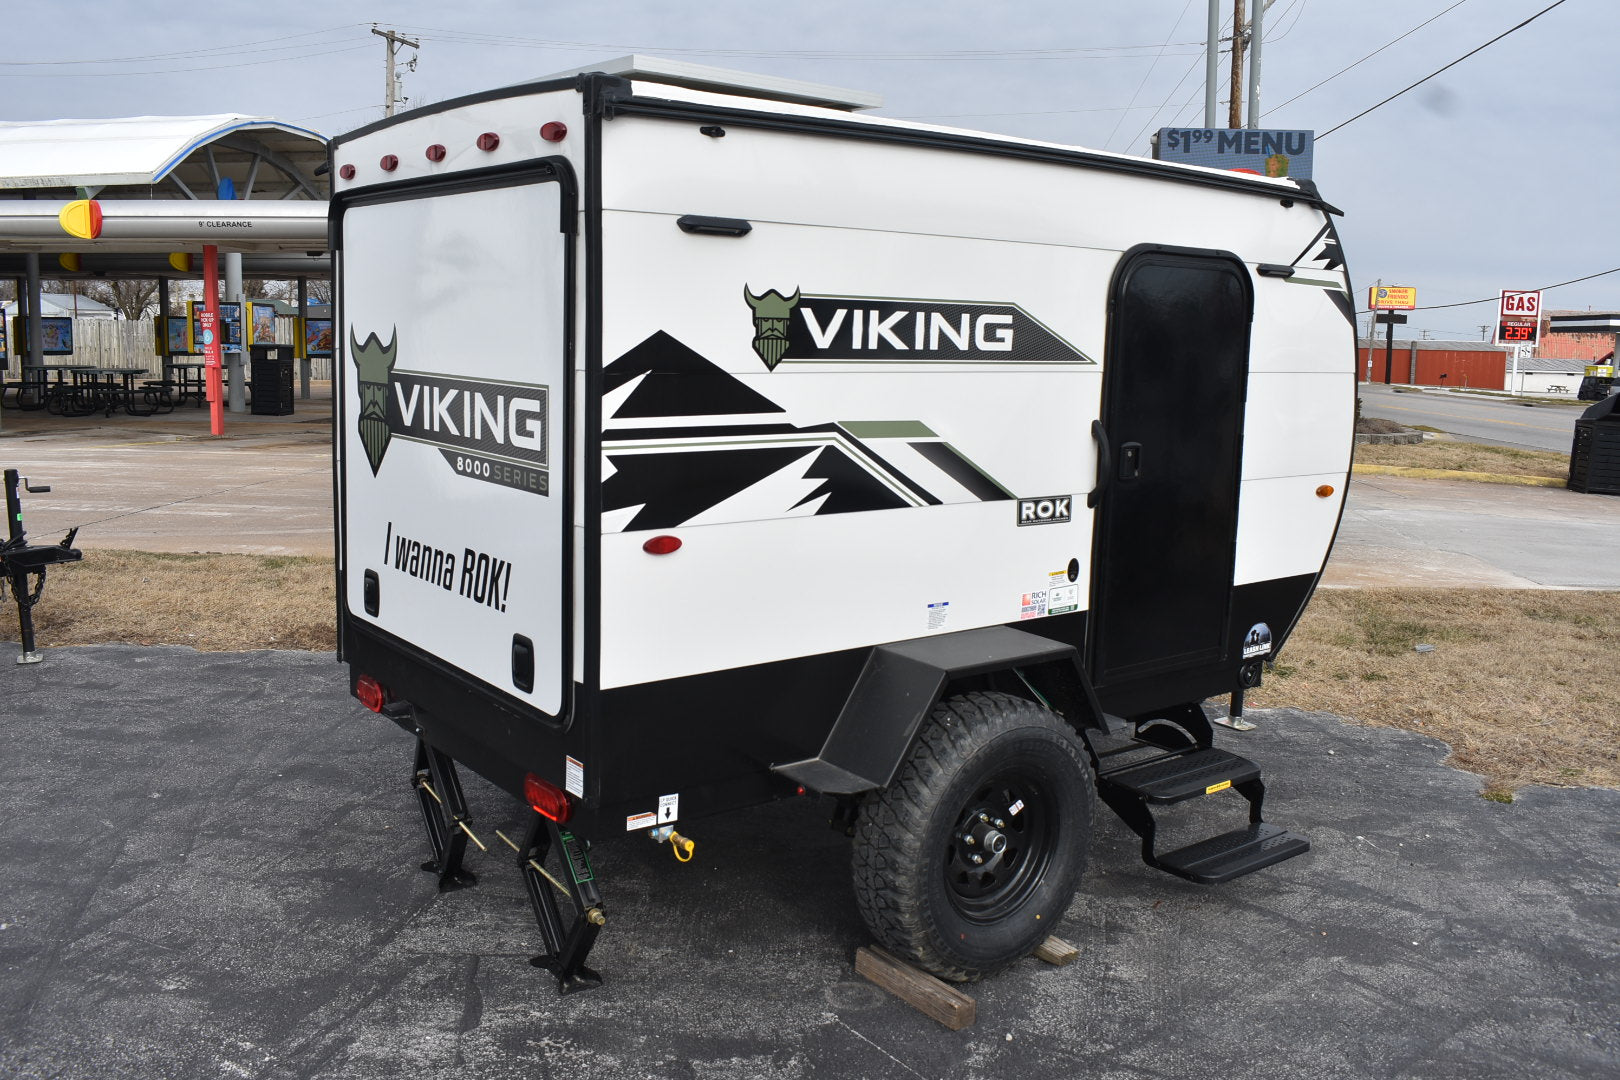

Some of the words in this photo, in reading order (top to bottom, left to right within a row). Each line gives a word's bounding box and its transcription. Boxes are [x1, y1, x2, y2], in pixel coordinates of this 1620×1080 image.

[1217, 131, 1306, 156] MENU
[206, 220, 253, 228] CLEARANCE
[1505, 295, 1536, 312] GAS
[800, 307, 1014, 352] VIKING
[394, 381, 542, 452] VIKING
[456, 456, 491, 478] 8000
[493, 464, 548, 492] SERIES
[1021, 499, 1070, 521] ROK
[383, 521, 392, 565] I
[394, 534, 456, 592] wanna
[459, 547, 512, 613] ROK!
[1031, 590, 1047, 600] RICH
